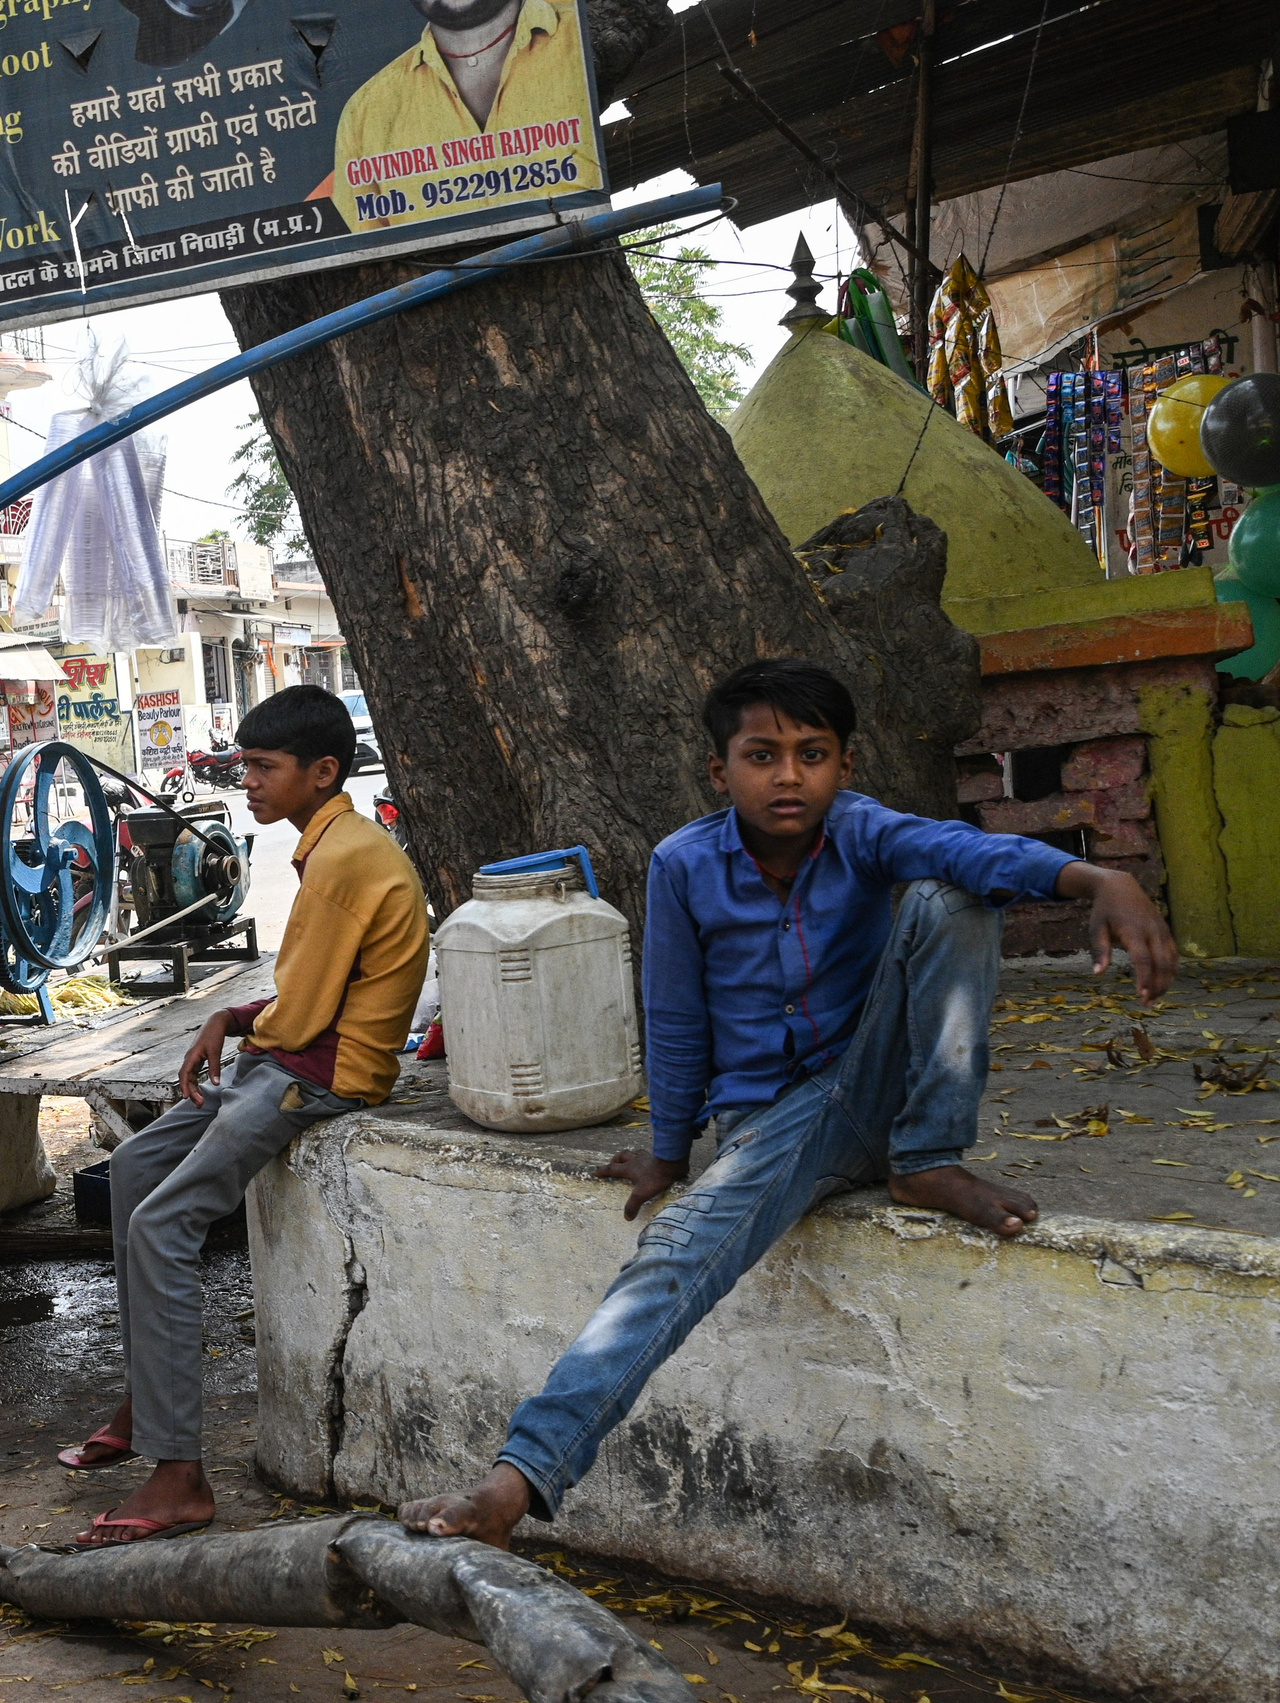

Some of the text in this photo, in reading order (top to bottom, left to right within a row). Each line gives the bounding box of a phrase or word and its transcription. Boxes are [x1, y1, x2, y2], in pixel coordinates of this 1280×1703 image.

[70, 58, 284, 127] हमारे यहां सभी प्रकार
[51, 91, 317, 177] की वीडियों ग्राफी एवं फोटो
[347, 118, 580, 186] GOVINDRA SINGH RAJPOOT
[165, 165, 194, 202] की
[200, 152, 254, 193] जाती
[260, 147, 276, 183] है
[355, 154, 578, 221] Mob. 9522912856
[39, 260, 59, 283] के
[137, 691, 180, 710] KASHISH
[138, 707, 181, 722] Beauty Parlour
